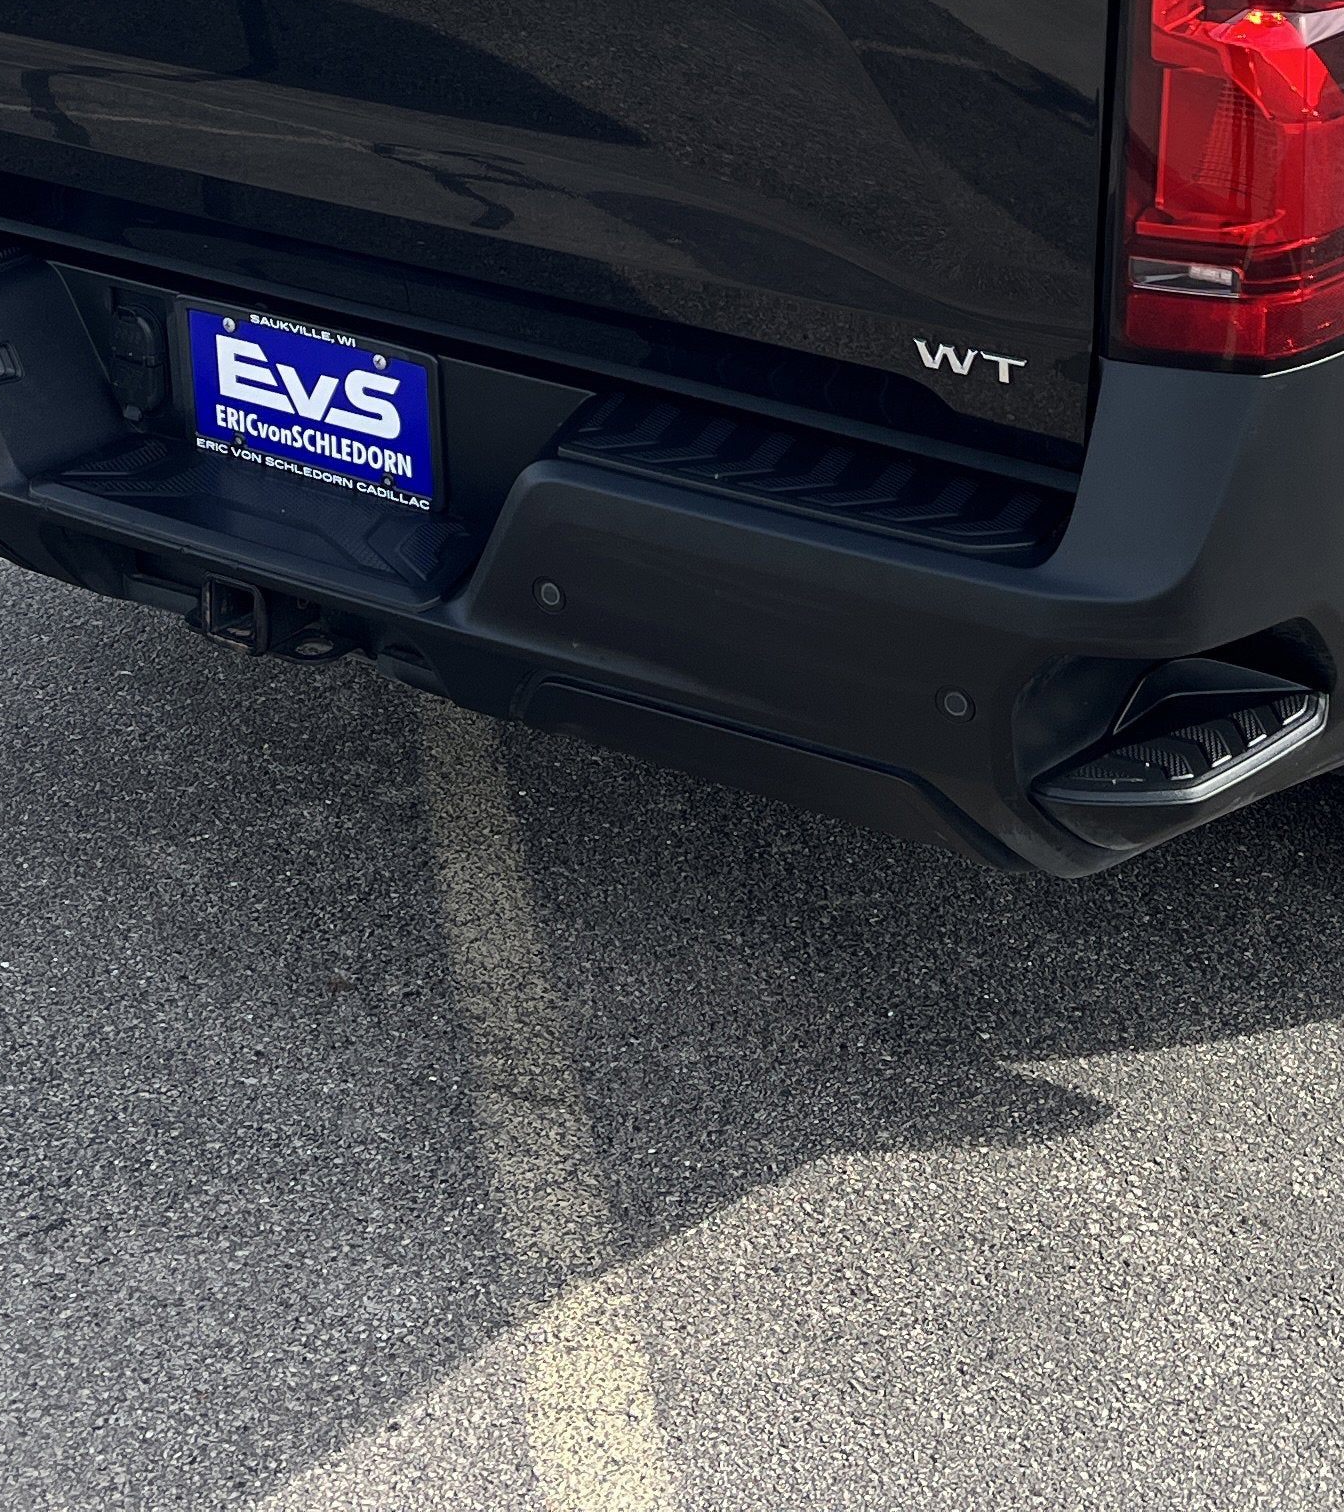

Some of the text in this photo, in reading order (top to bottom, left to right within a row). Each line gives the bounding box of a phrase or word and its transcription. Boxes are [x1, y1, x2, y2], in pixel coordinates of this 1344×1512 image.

[249, 314, 356, 348] SAUKVILLE, WI
[913, 338, 1027, 384] WT
[215, 404, 412, 478] ERICvonSCHLEDORN
[196, 437, 430, 510] ERIC VON SCHLEDORN CADILLAC
